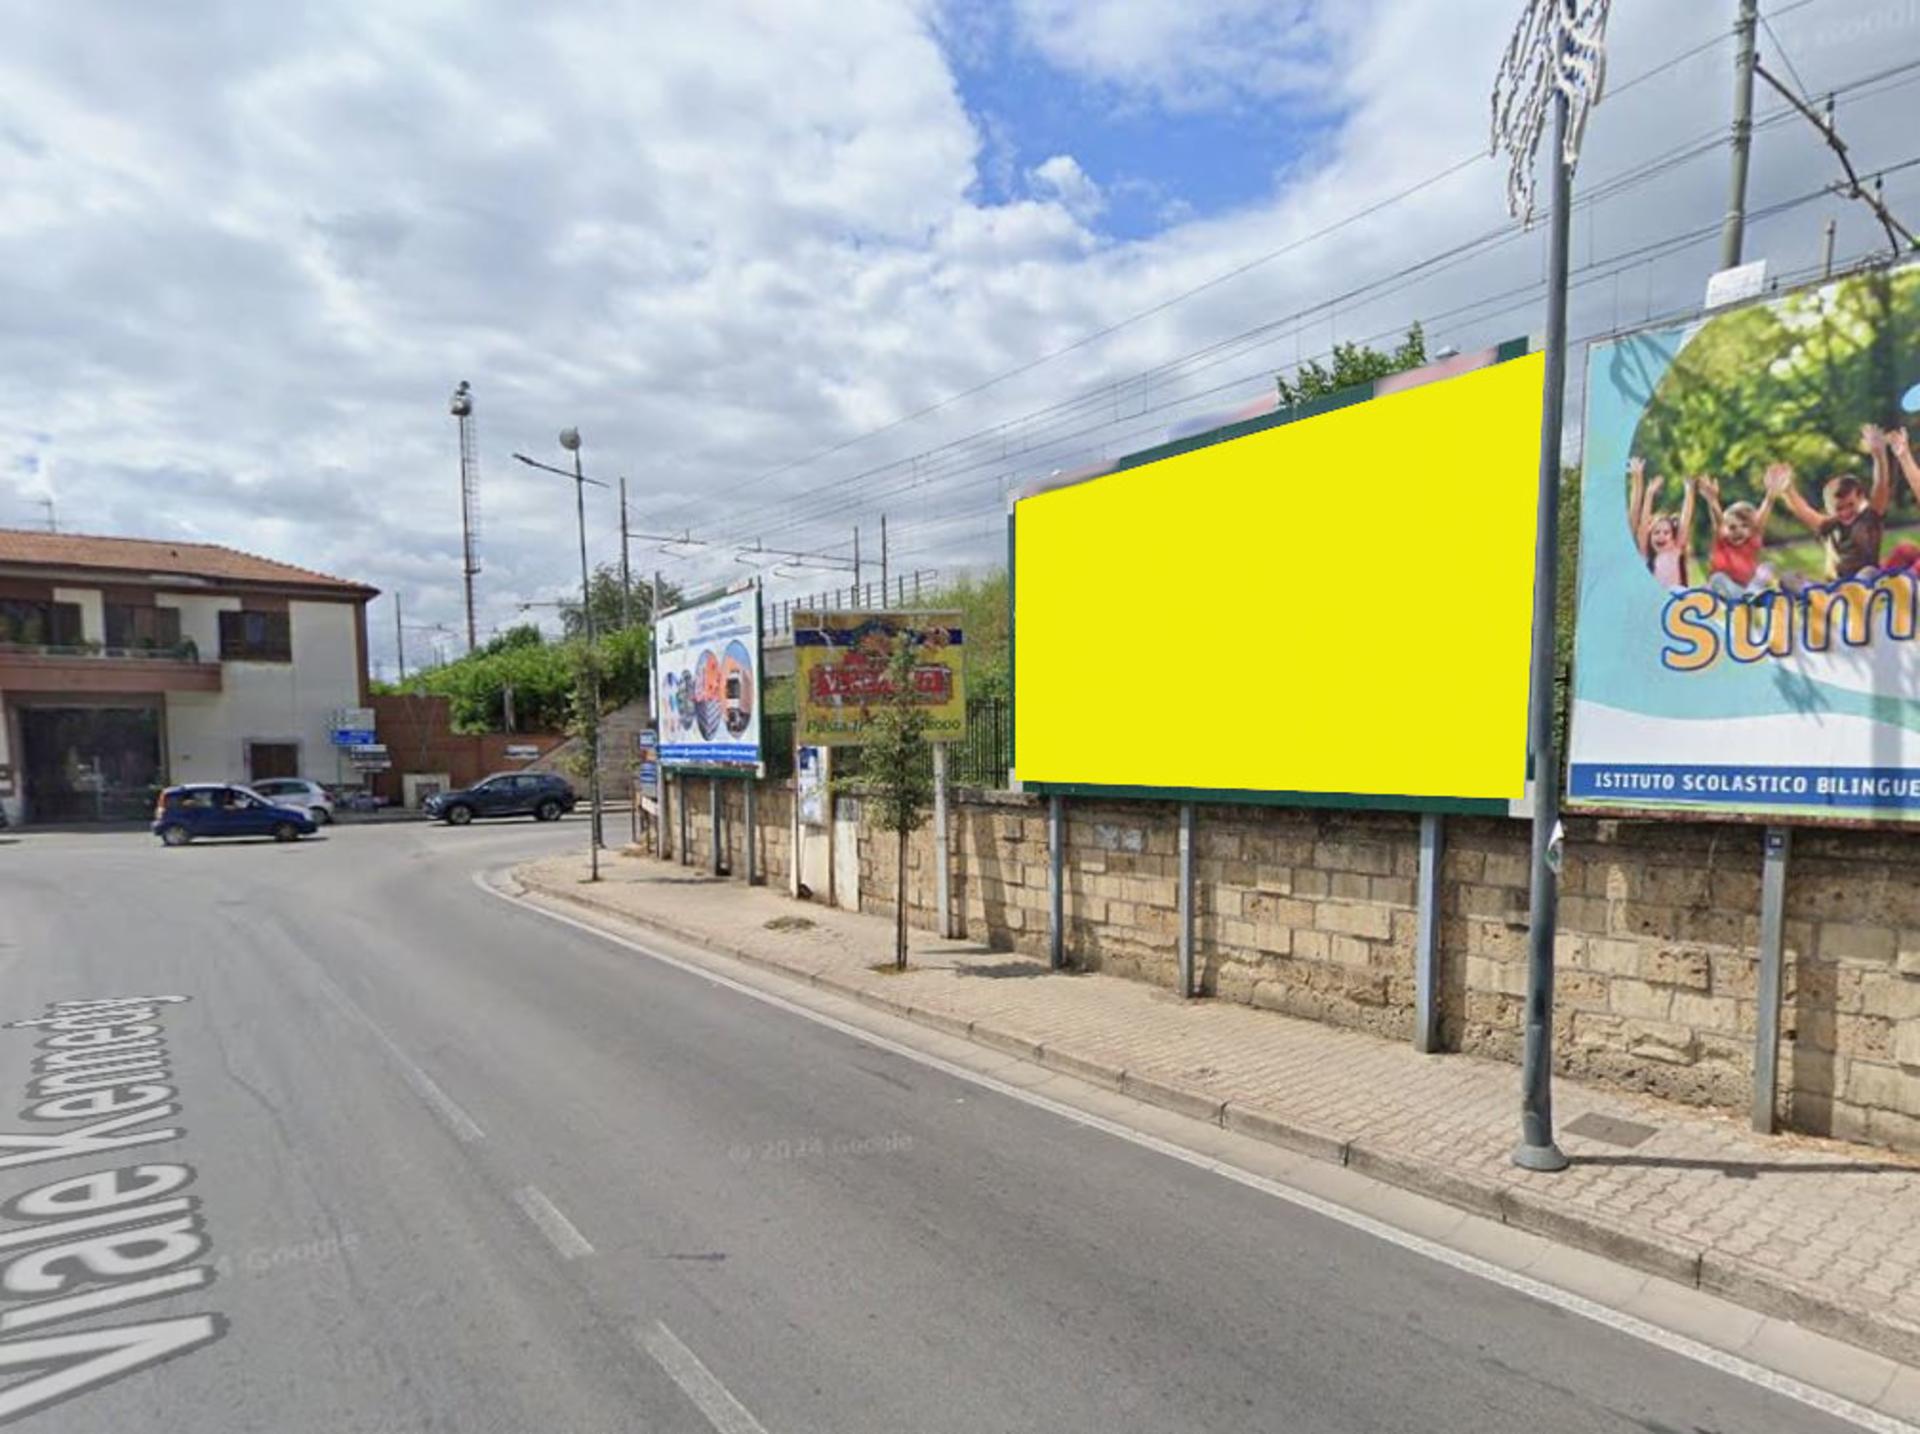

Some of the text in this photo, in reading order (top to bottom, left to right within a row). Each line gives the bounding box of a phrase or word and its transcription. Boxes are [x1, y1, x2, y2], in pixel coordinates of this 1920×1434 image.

[1594, 771, 1920, 798] ISTITUTO SCOLASTICO BILINGUE
